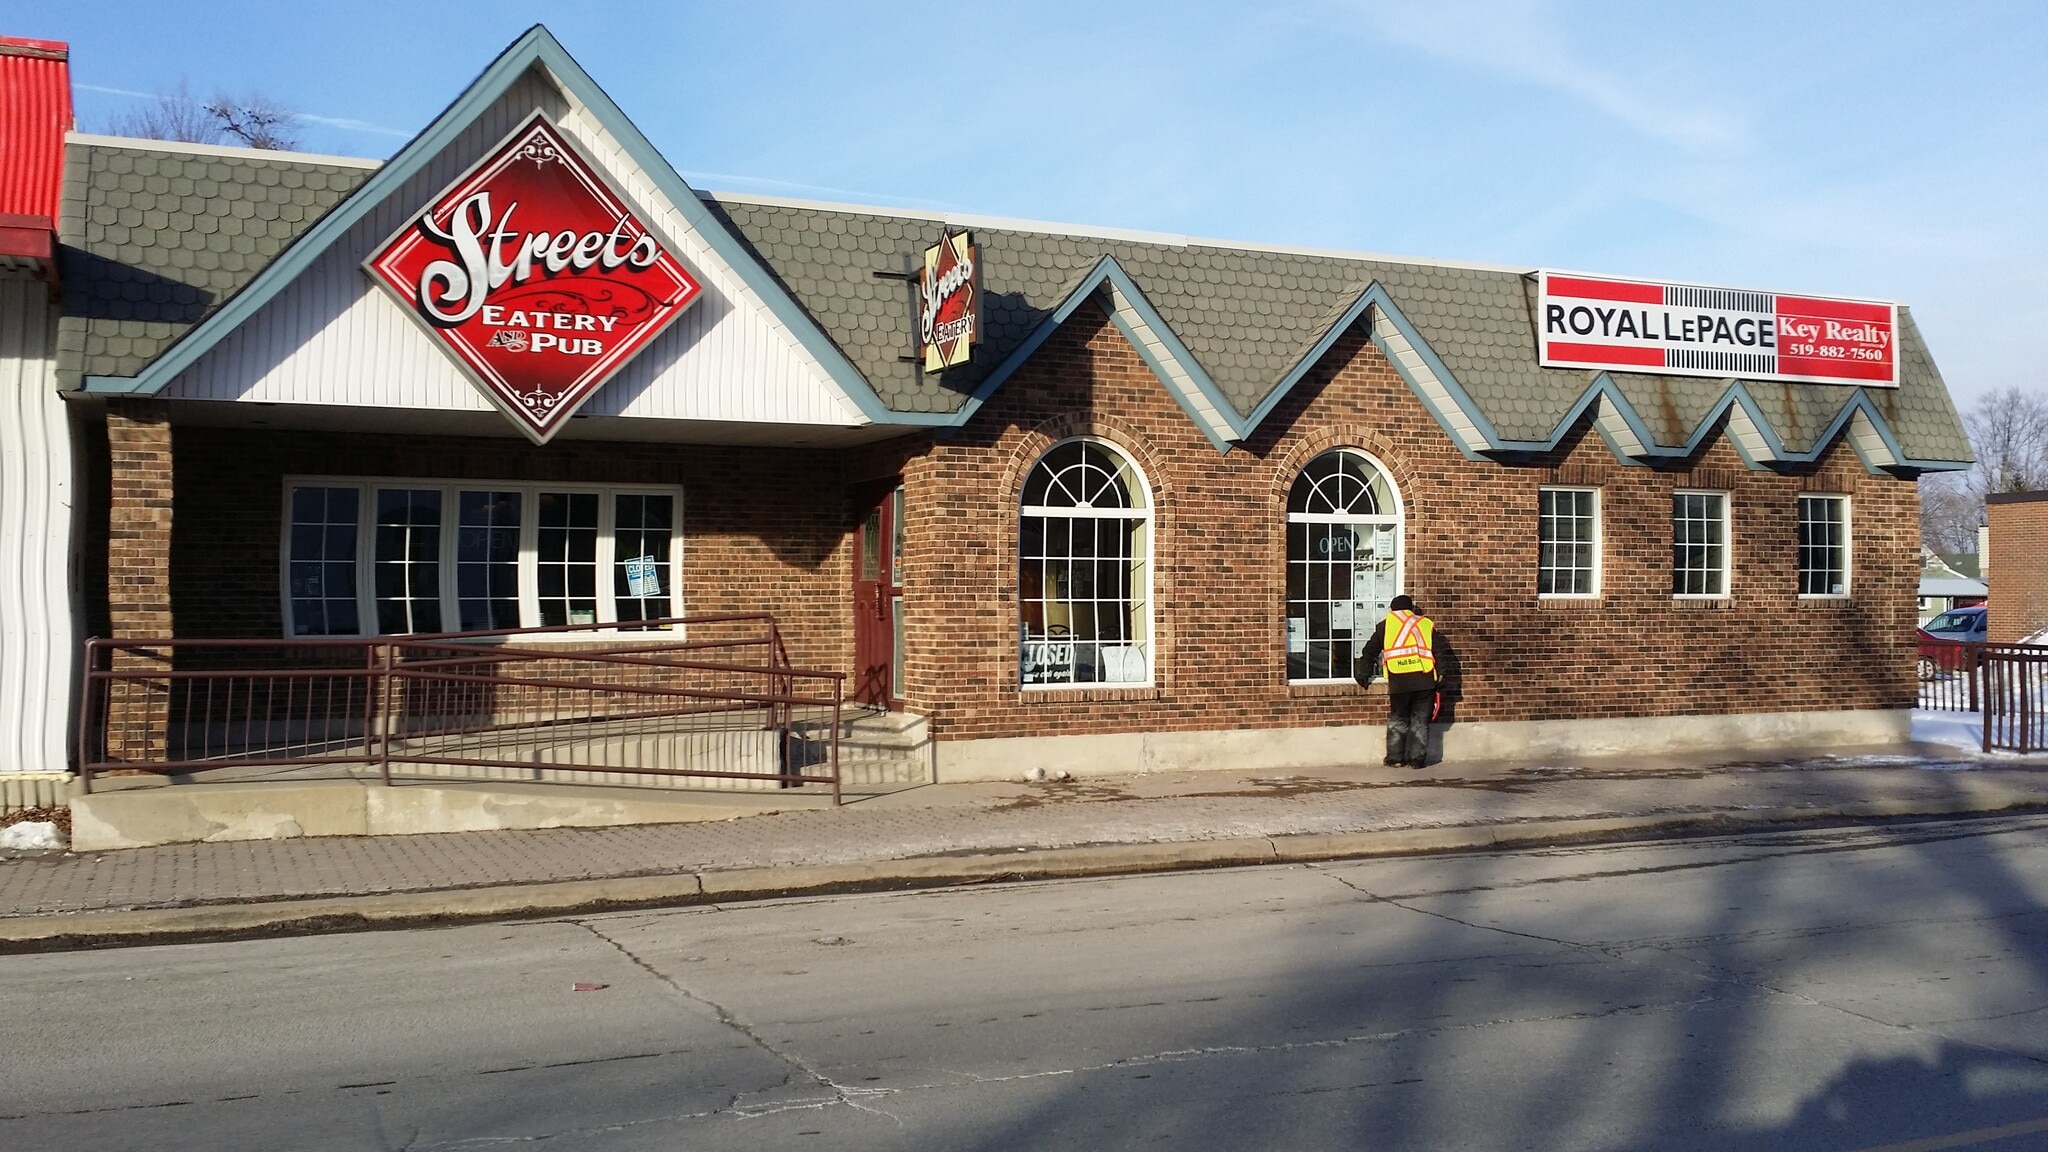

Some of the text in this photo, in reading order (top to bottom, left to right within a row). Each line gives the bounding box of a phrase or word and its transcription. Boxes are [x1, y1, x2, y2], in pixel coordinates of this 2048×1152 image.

[420, 191, 663, 322] Streets
[482, 304, 618, 332] EATERY
[936, 314, 975, 343] EATERY
[1547, 303, 1659, 340] ROYAL
[530, 332, 603, 355] PUB
[1778, 316, 1891, 348] Key Realty
[1789, 343, 1883, 360] 519-882-7560
[1319, 536, 1353, 553] OPEN
[628, 563, 654, 574] CLOED
[1025, 644, 1074, 666] LOSED
